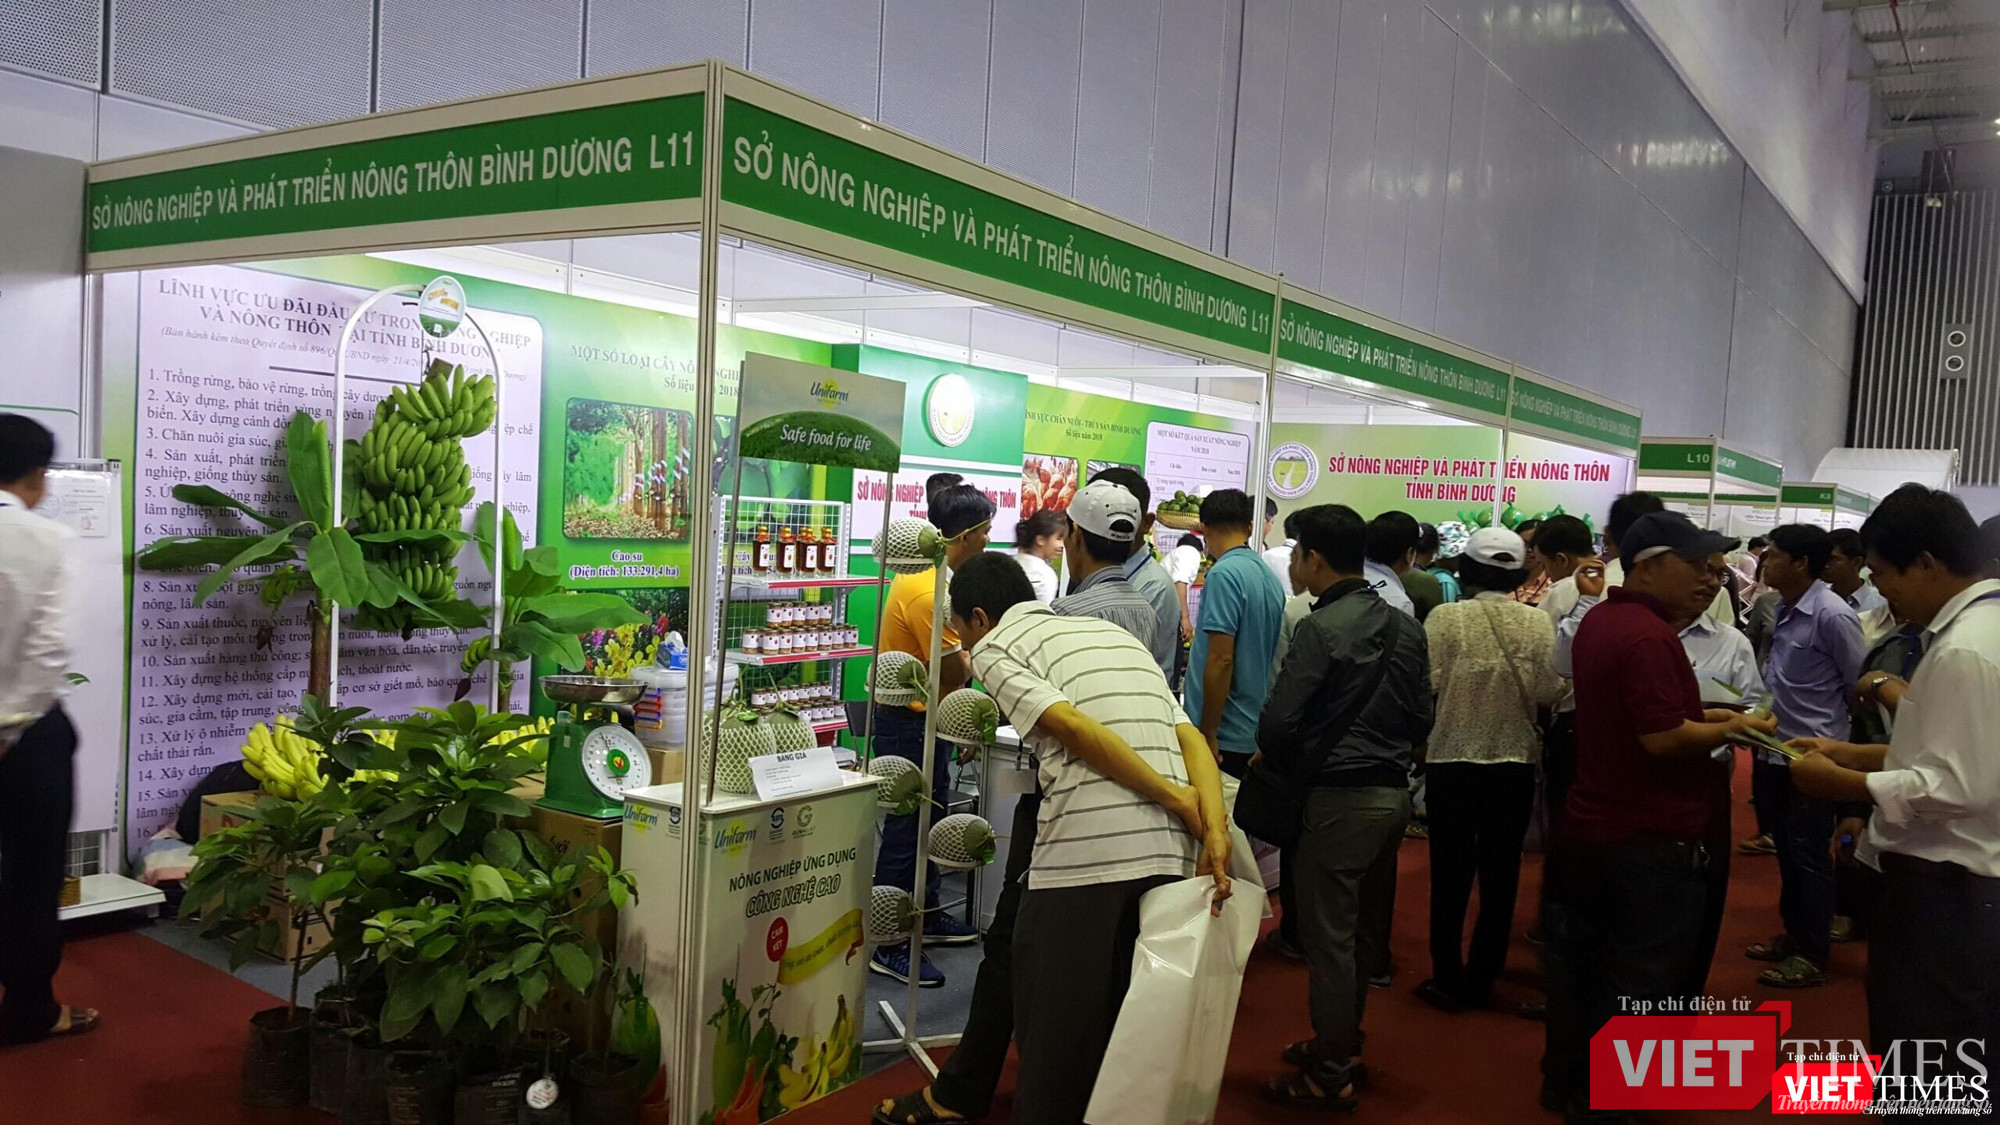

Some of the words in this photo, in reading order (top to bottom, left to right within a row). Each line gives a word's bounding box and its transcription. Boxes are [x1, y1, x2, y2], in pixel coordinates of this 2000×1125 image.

[92, 195, 110, 230] SỞ
[114, 195, 152, 226] NÔNG
[157, 186, 212, 223] NGHIỆP
[218, 179, 237, 214] VÀ
[243, 173, 288, 211] PHÁT
[292, 158, 345, 204] TRIỂN
[352, 161, 408, 199] NÔNG
[415, 151, 473, 192] THÔN
[480, 144, 534, 186] BÌNH
[542, 137, 632, 179] DƯƠNG
[650, 131, 693, 168] L11
[734, 130, 773, 180] SỞ
[782, 152, 855, 207] NÔNG
[863, 192, 946, 238] NGHIỆP
[953, 207, 977, 246] VÀ
[984, 224, 1032, 262] PHÁT
[1036, 235, 1085, 279] TRIỂN
[1089, 254, 1131, 293] NÔNG
[1135, 272, 1171, 306] THÔN
[1175, 280, 1204, 316] BÌNH
[1207, 296, 1247, 328] DƯƠNG
[1251, 310, 1269, 335] L11
[160, 279, 204, 299] LĨNH
[210, 287, 249, 306] VỰC
[254, 293, 278, 310] ƯU
[283, 297, 311, 315] ĐÃI
[380, 313, 420, 332] TRON
[200, 305, 224, 322] VÀ
[230, 309, 280, 329] NÔNG
[285, 318, 331, 336] THÔN
[451, 341, 496, 359] DƯƠN
[571, 345, 600, 362] MỘT
[622, 352, 650, 369] LOẠI
[1280, 312, 1295, 341] SỞ
[1297, 321, 1323, 350] NÔNG
[1326, 332, 1359, 363] NGHIỆP
[1361, 340, 1371, 364] VÀ
[1373, 345, 1394, 370] PHÁT
[1396, 348, 1417, 376] TRIỂN
[1419, 360, 1439, 383] NÔNG
[1440, 366, 1458, 387] THÔN
[150, 369, 159, 381] 1.
[164, 369, 200, 387] Trồng
[203, 375, 235, 390] rừng,
[239, 378, 259, 391] bảo
[264, 383, 276, 394] vệ
[279, 383, 307, 398] rừng,
[312, 384, 334, 399] trồn
[664, 374, 676, 388] Số
[678, 379, 695, 392] liệu
[719, 384, 739, 397] 2018
[148, 390, 158, 401] 2.
[165, 390, 190, 406] Xây
[195, 394, 229, 409] dựng,
[234, 398, 259, 412] phát
[264, 400, 289, 413] triển
[147, 405, 177, 421] biến.
[182, 409, 206, 426] Xây
[210, 412, 240, 428] dựng
[243, 415, 269, 428] cánh
[146, 427, 158, 440] 3.
[162, 428, 194, 442] Chăn
[198, 433, 224, 444] nuôi
[228, 435, 245, 447] gia
[249, 436, 271, 448] súc,
[780, 424, 806, 444] Safe
[808, 428, 834, 448] food
[835, 433, 852, 449] for
[854, 434, 872, 453] life
[1329, 452, 1345, 472] SỞ
[1348, 455, 1380, 474] NÔNG
[1384, 456, 1429, 475] NGHIỆP
[1433, 456, 1448, 476] VÀ
[1452, 458, 1485, 477] PHÁT
[1489, 455, 1527, 479] TIỂN
[1531, 460, 1569, 480] NÔNG
[1574, 461, 1610, 481] THÔN
[1687, 453, 1710, 464] L10
[857, 476, 870, 501] SỞ
[871, 479, 893, 502] NÔN
[896, 482, 924, 504] NGHIỆP
[999, 488, 1016, 509] THÔN
[1406, 477, 1434, 499] TỈNH
[1437, 480, 1468, 500] BÌNH
[611, 550, 630, 563] Cao
[631, 553, 643, 562] su
[569, 566, 597, 579] (Diện
[598, 565, 620, 577] tích:
[622, 566, 663, 578] 133.291,4
[665, 565, 680, 578] ha)
[138, 748, 163, 762] chất
[167, 748, 190, 759] thải
[193, 742, 215, 756] rắn.
[729, 871, 761, 892] NÔNG
[763, 860, 802, 883] NGHIỆP
[803, 854, 825, 871] ỨNG
[828, 848, 857, 868] DỤNG
[745, 889, 782, 918] CÔNG
[782, 876, 817, 904] NGHỆ
[816, 873, 841, 898] CAO
